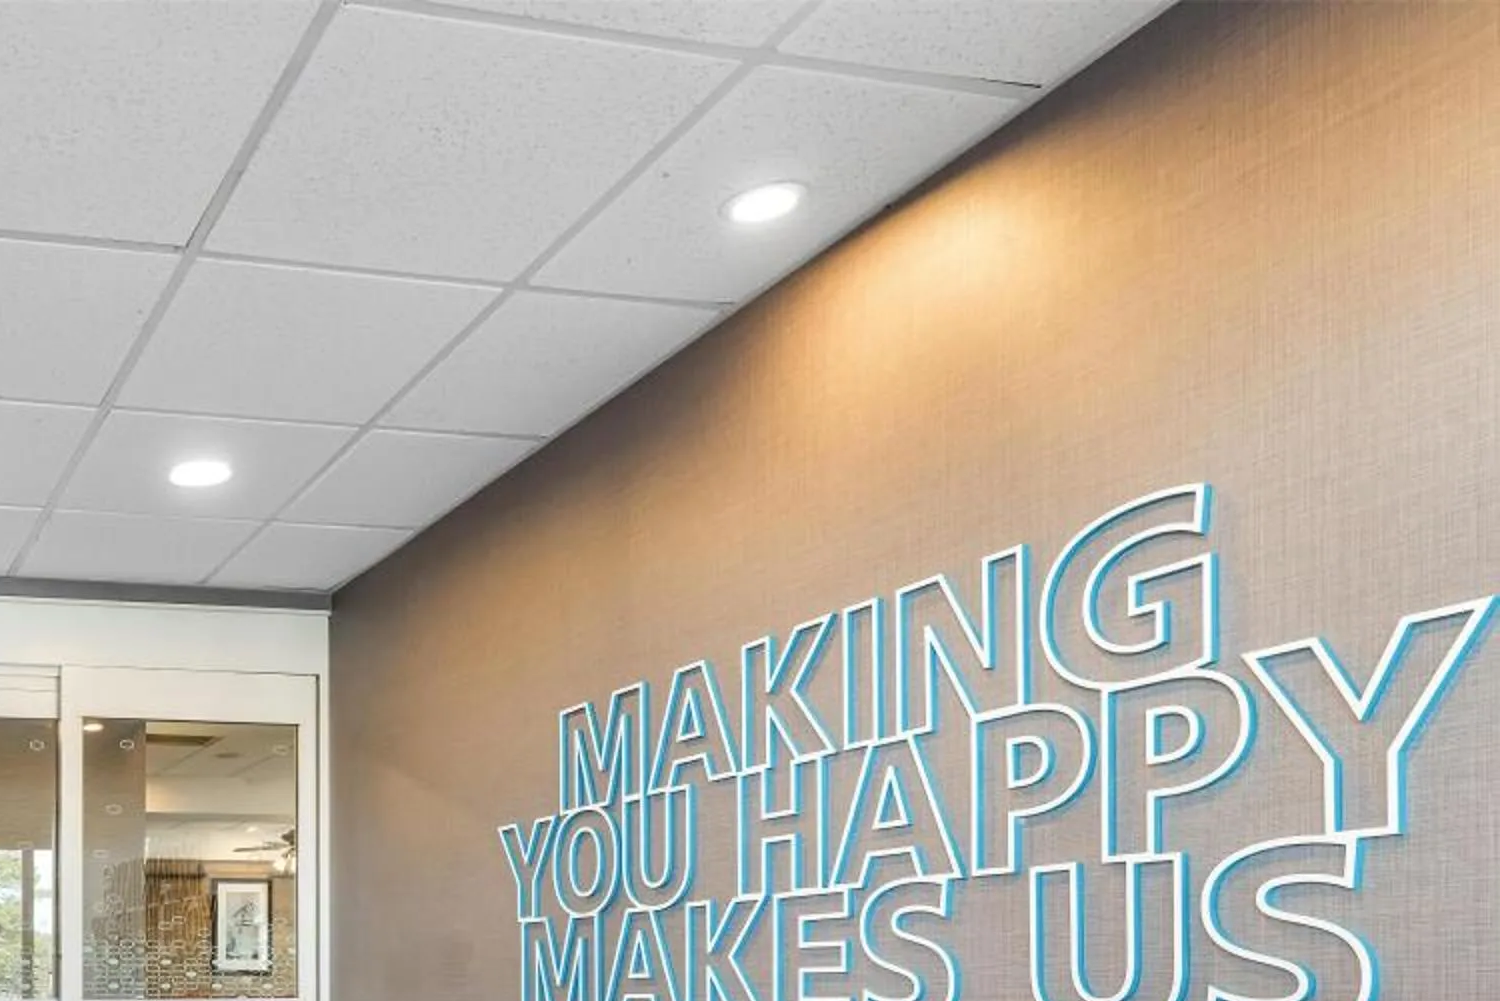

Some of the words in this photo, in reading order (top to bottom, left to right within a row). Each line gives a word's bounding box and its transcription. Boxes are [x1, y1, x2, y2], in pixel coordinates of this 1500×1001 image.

[498, 786, 695, 921] YOU
[737, 595, 1498, 898] HAPPY
[559, 482, 1220, 814] MAKING
